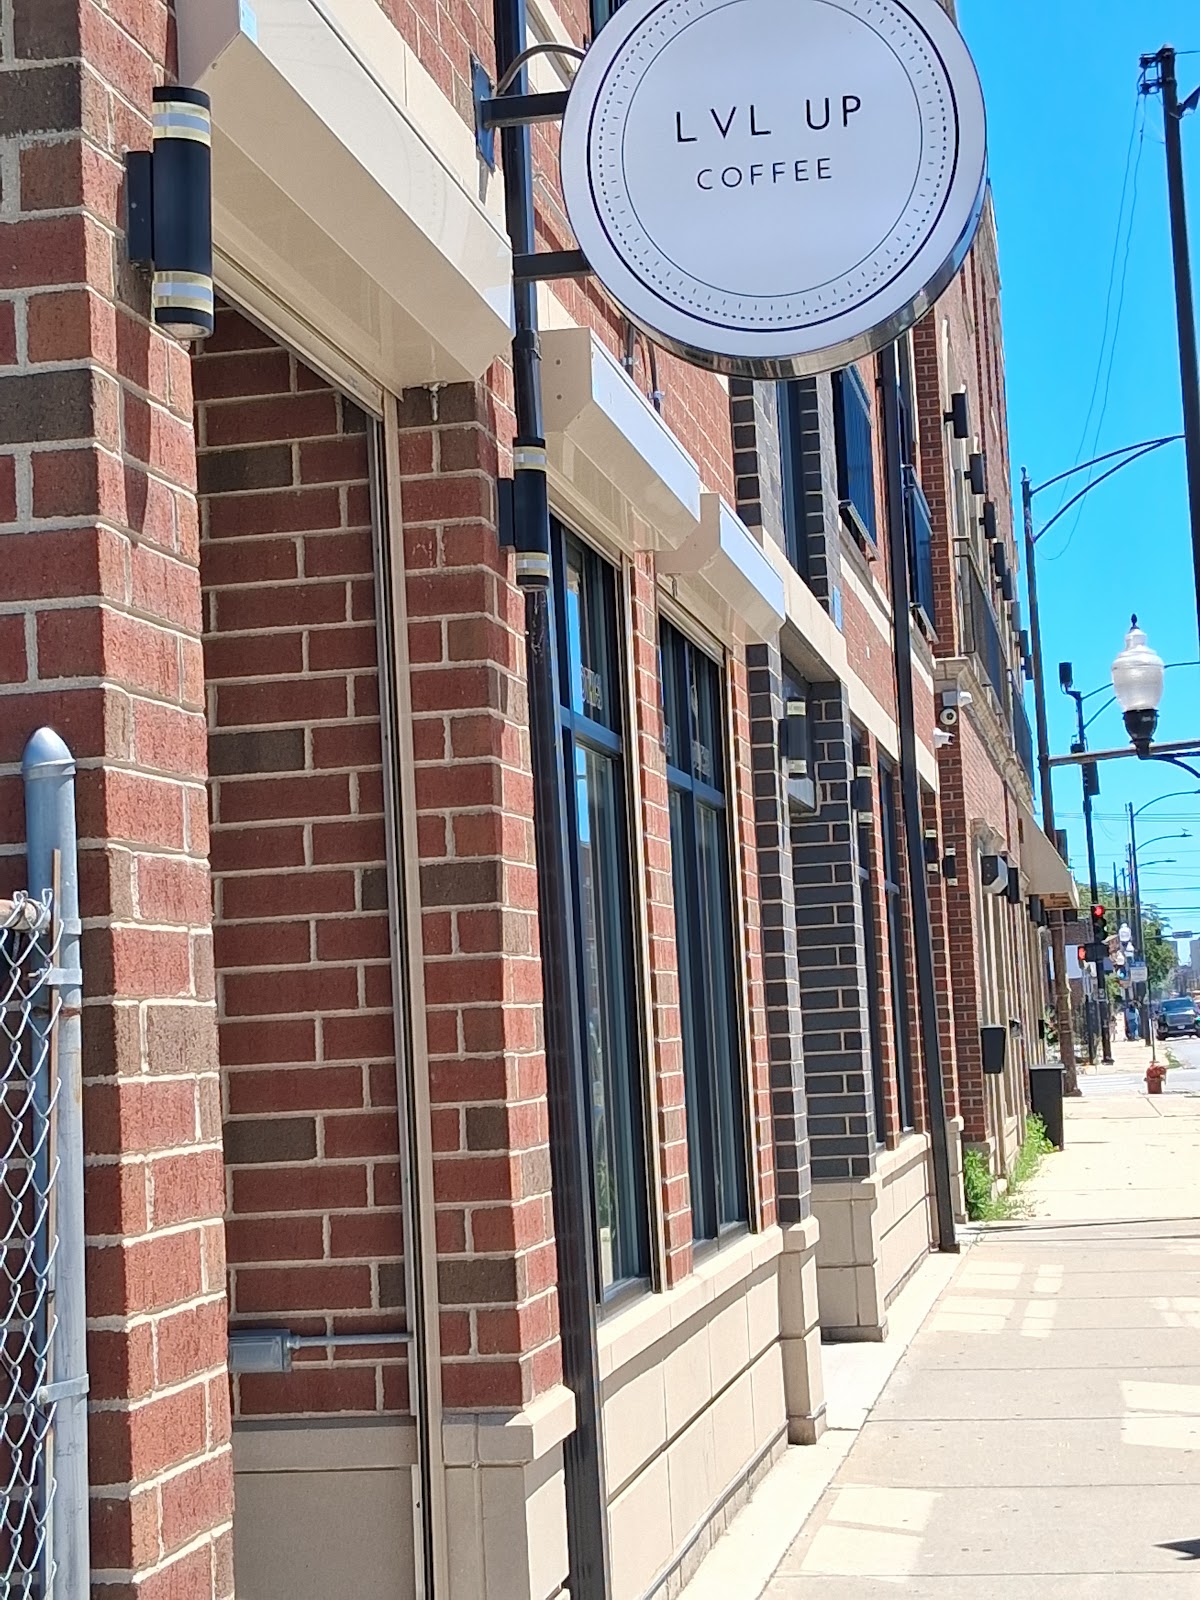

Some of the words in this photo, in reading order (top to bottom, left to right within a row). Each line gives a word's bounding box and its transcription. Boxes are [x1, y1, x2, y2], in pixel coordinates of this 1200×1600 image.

[675, 104, 772, 143] LVL
[805, 95, 862, 131] UP
[697, 157, 833, 190] COFFEE
